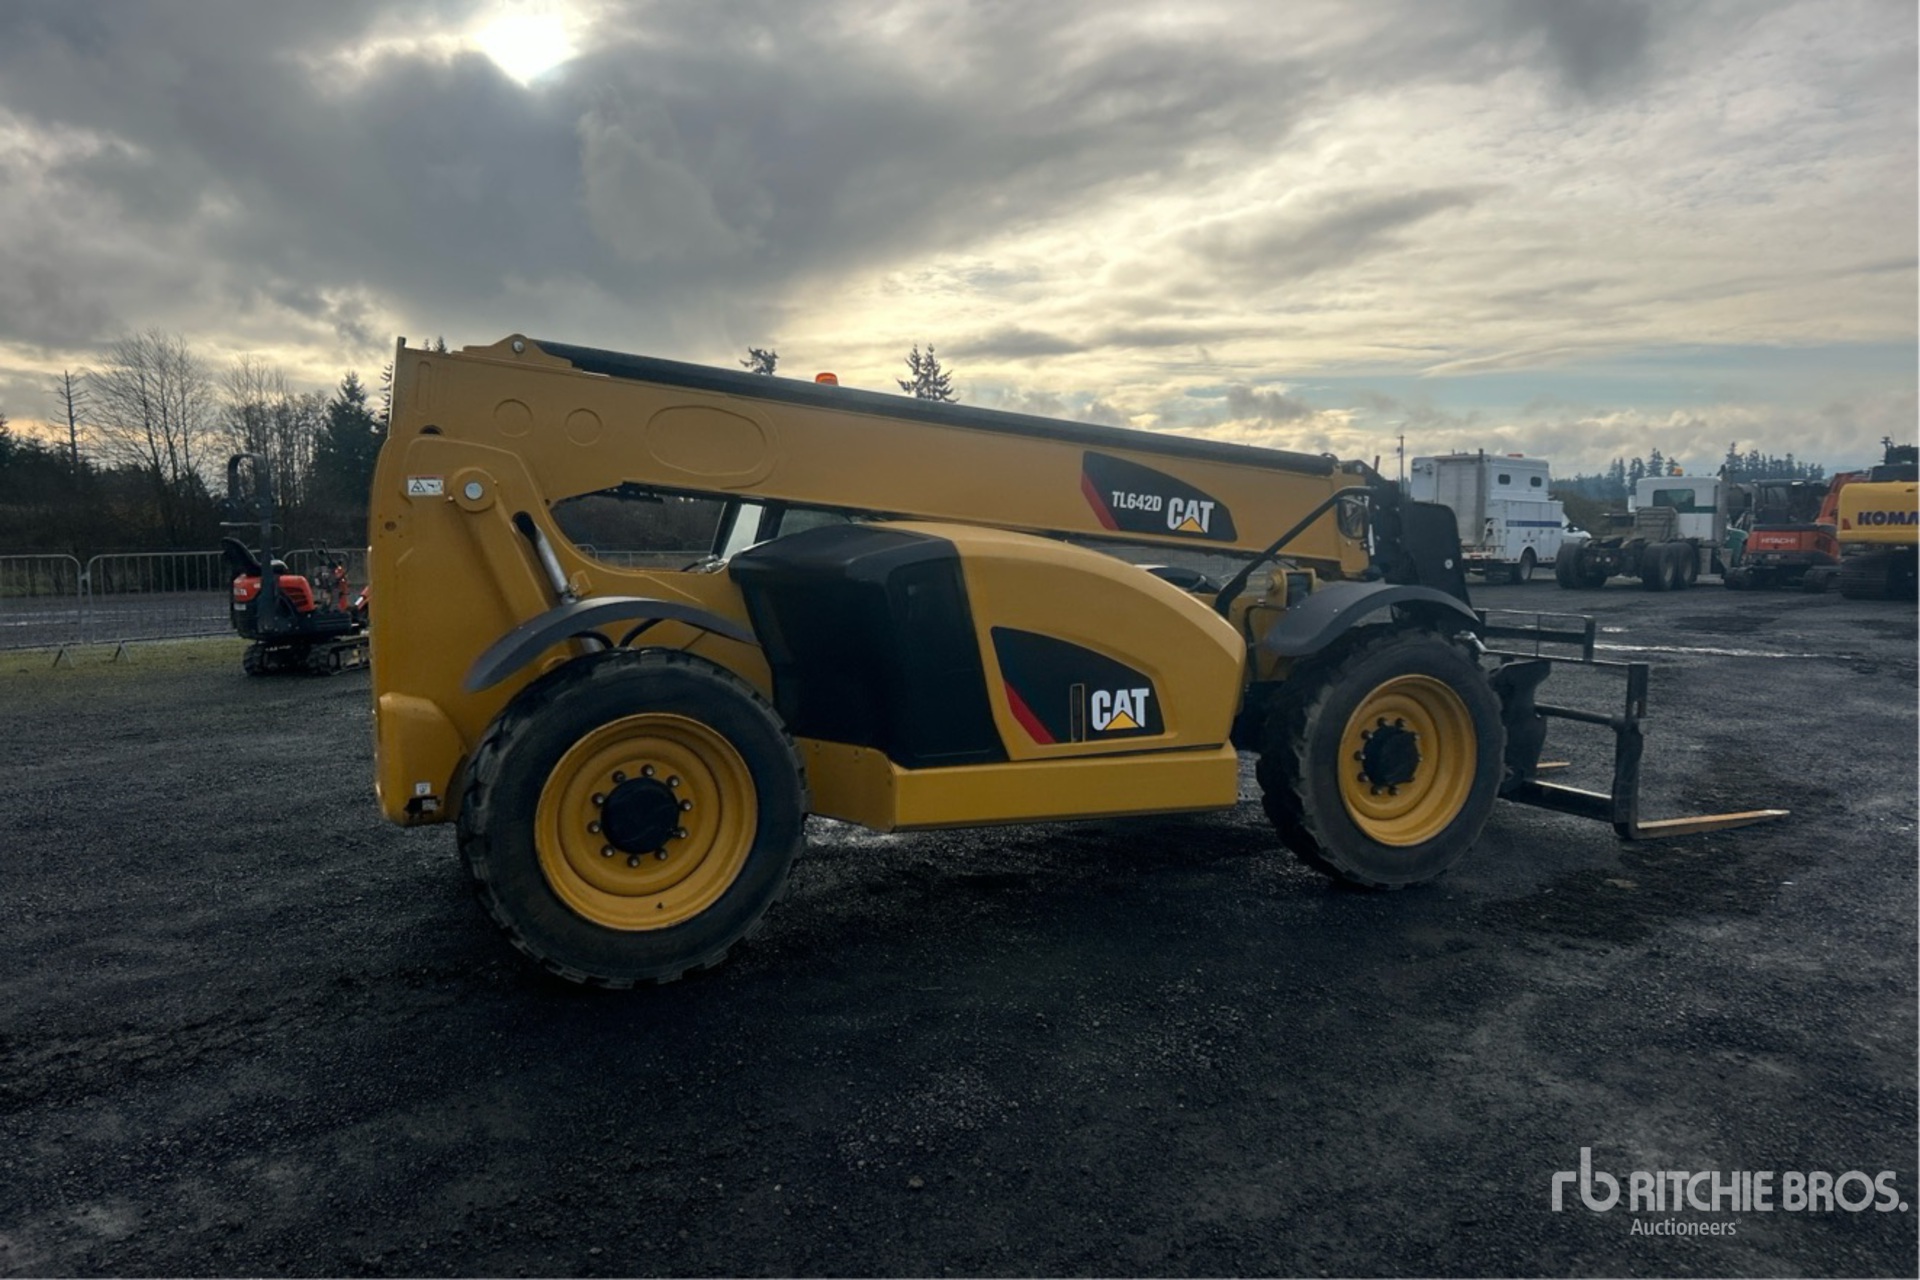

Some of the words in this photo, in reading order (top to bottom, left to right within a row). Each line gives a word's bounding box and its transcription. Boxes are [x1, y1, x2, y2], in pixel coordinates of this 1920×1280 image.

[1112, 491, 1162, 512] TL642D
[1167, 498, 1214, 533] CAT
[1091, 688, 1149, 731] CAT
